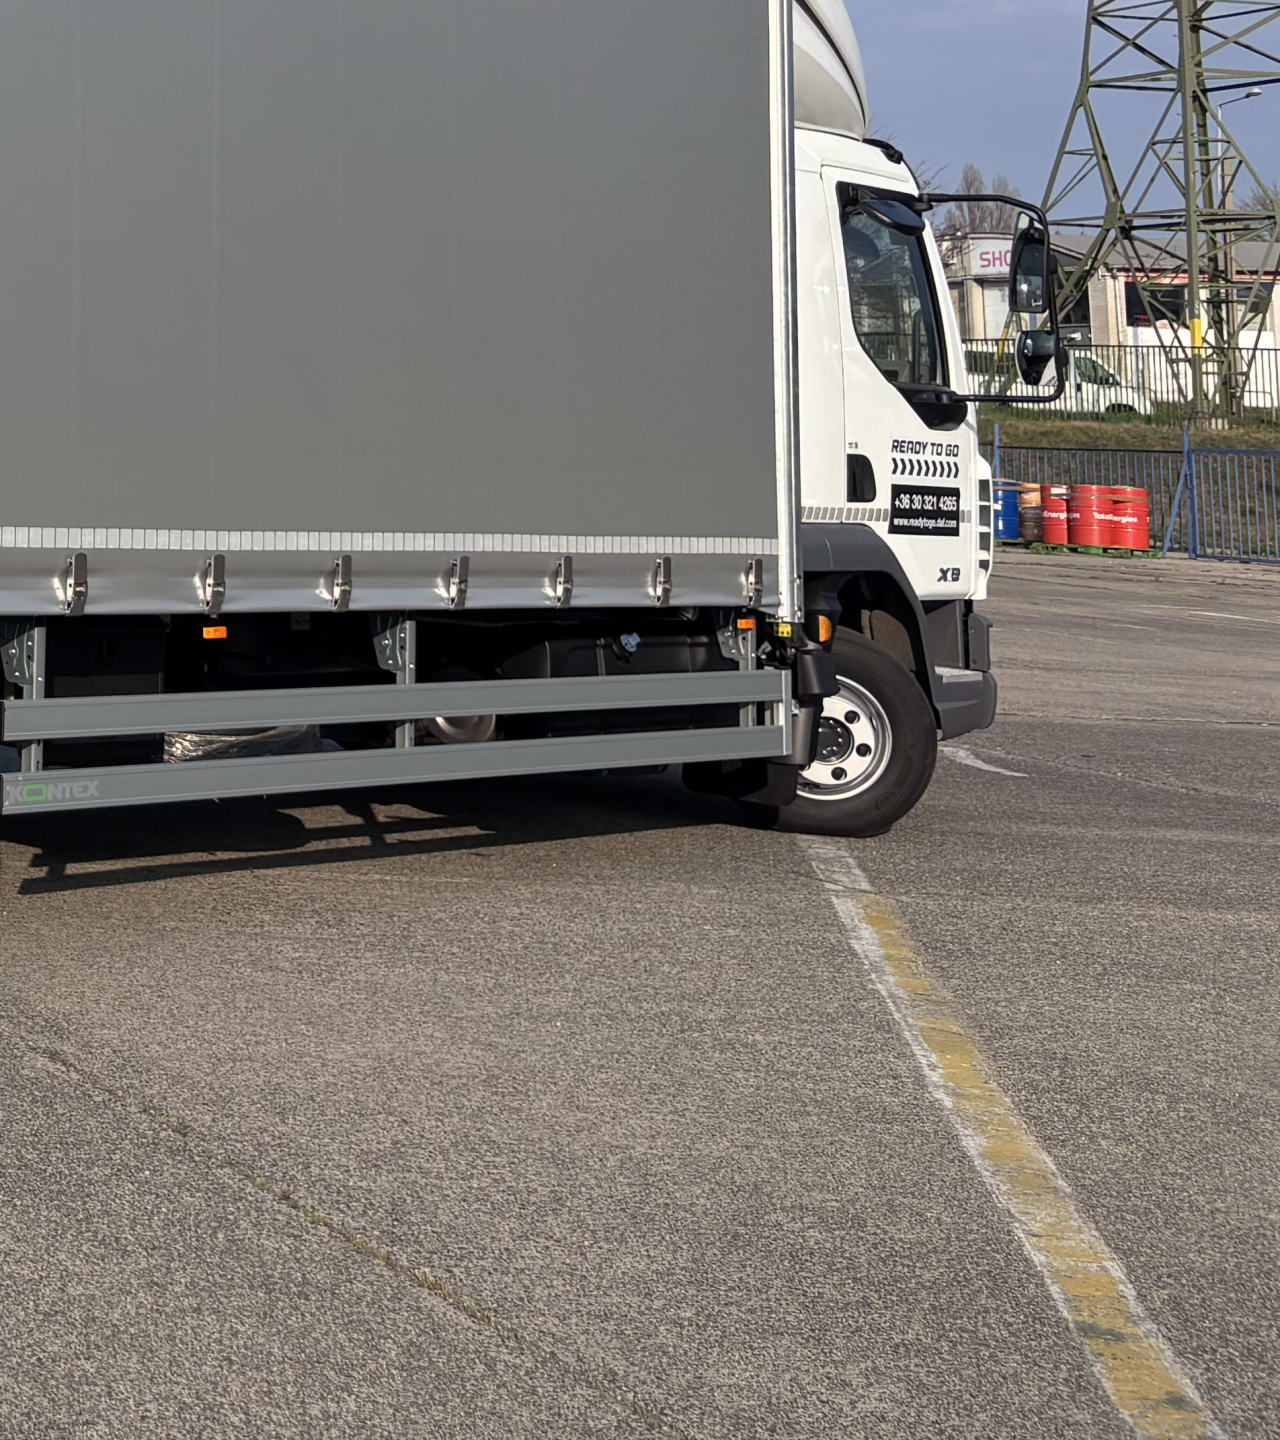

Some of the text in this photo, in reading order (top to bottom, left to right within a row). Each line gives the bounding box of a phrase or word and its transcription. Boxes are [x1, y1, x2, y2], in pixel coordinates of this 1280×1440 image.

[891, 439, 959, 457] READY TO GO
[894, 493, 957, 511] +36 30 321 4265
[8, 780, 100, 804] KONTEX
